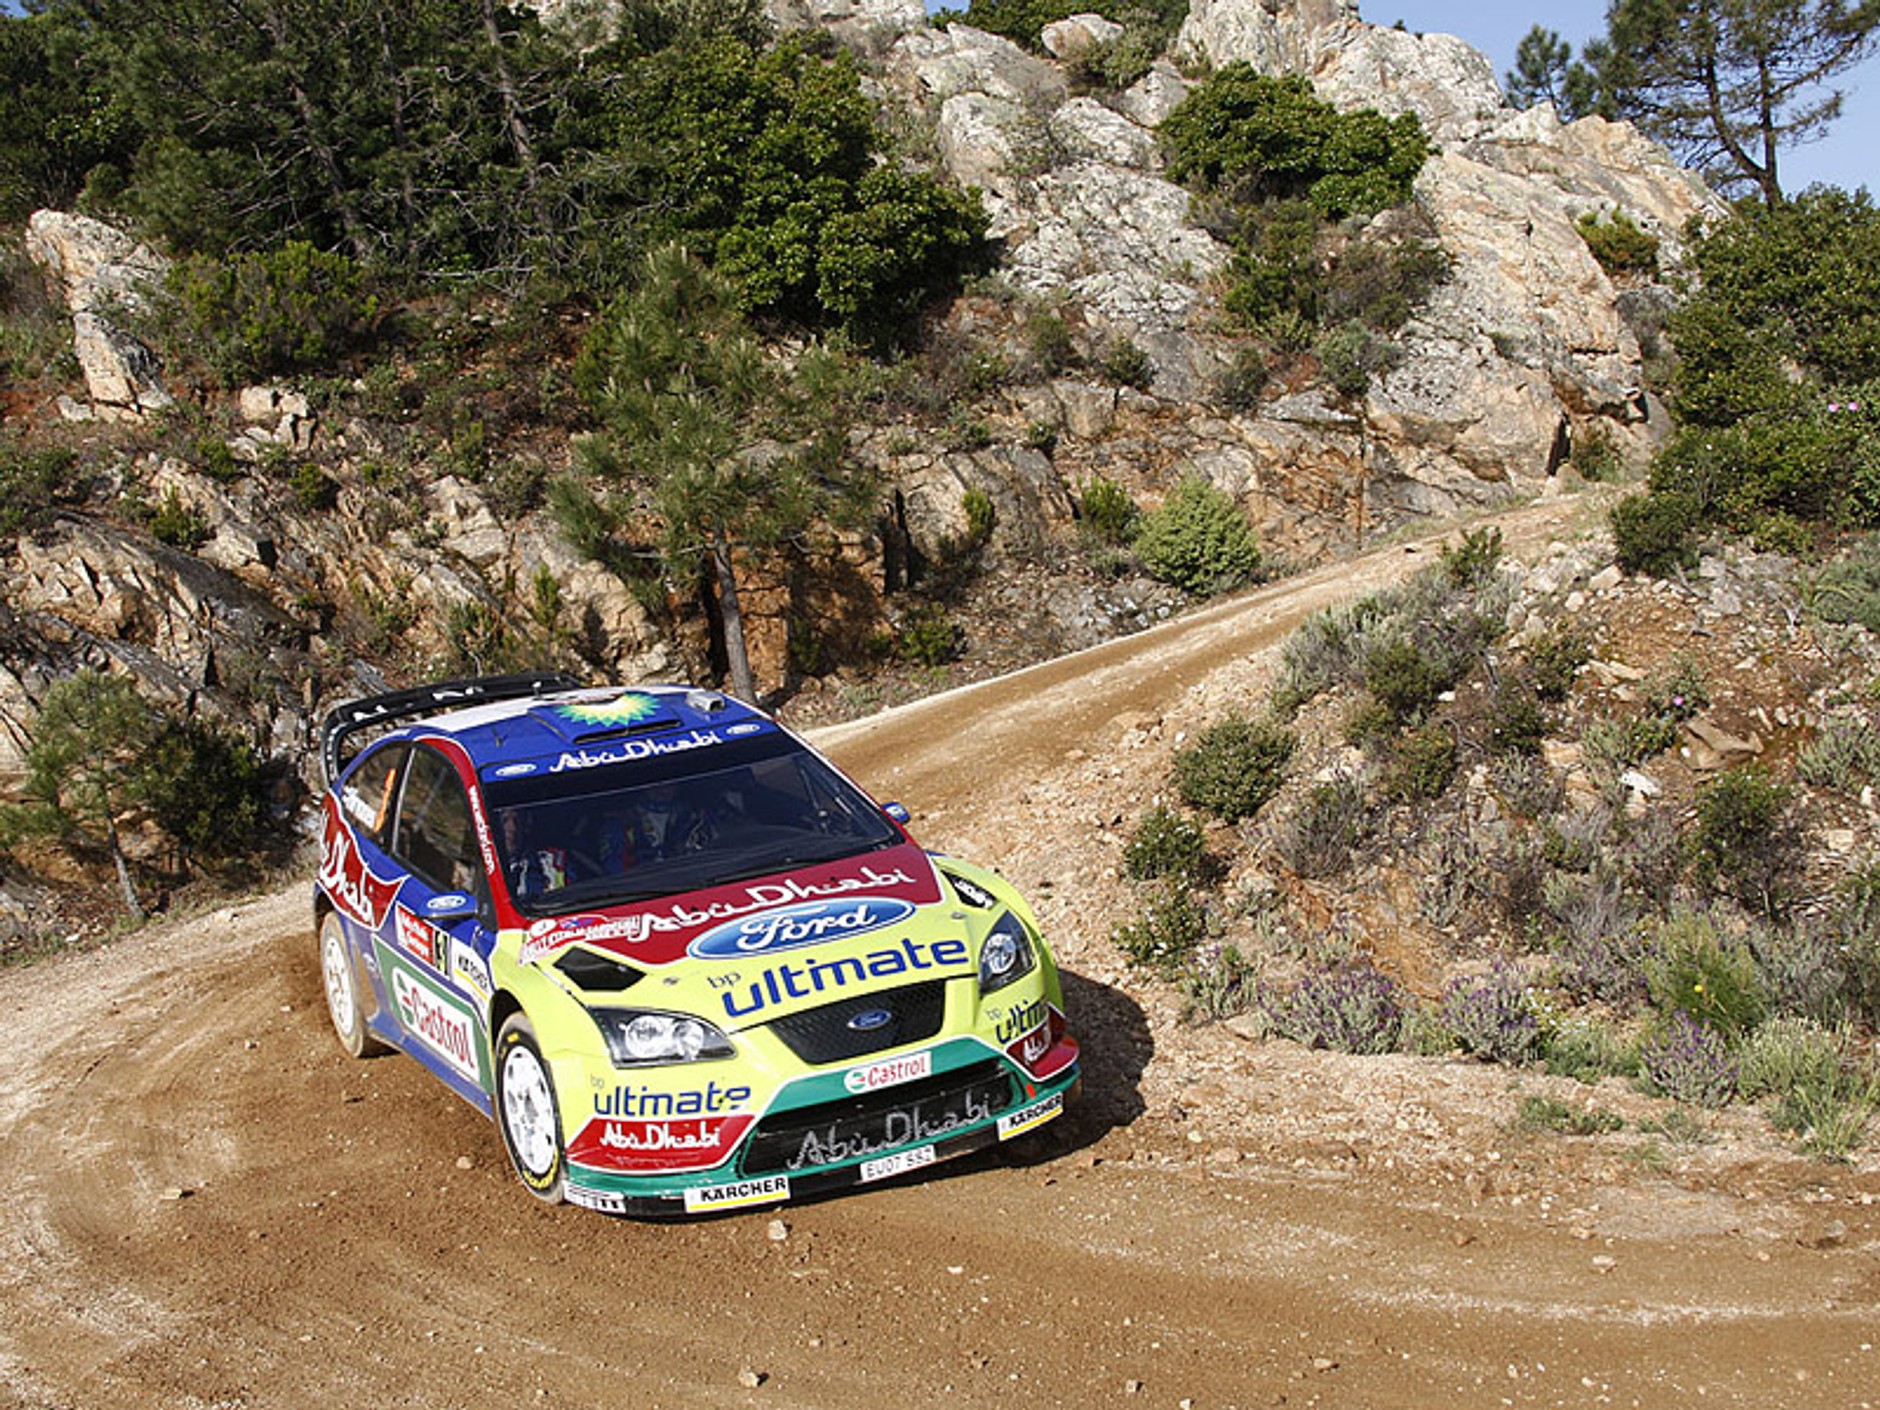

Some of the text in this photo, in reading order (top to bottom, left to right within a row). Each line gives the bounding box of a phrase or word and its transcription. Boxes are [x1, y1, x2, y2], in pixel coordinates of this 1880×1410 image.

[737, 905, 878, 951] Ford
[707, 971, 742, 990] bp
[722, 938, 970, 1018] ultimate
[412, 986, 475, 1069] Castrol
[867, 1055, 926, 1088] Castrol
[594, 1081, 751, 1117] ultimate
[865, 1156, 902, 1178] EU07
